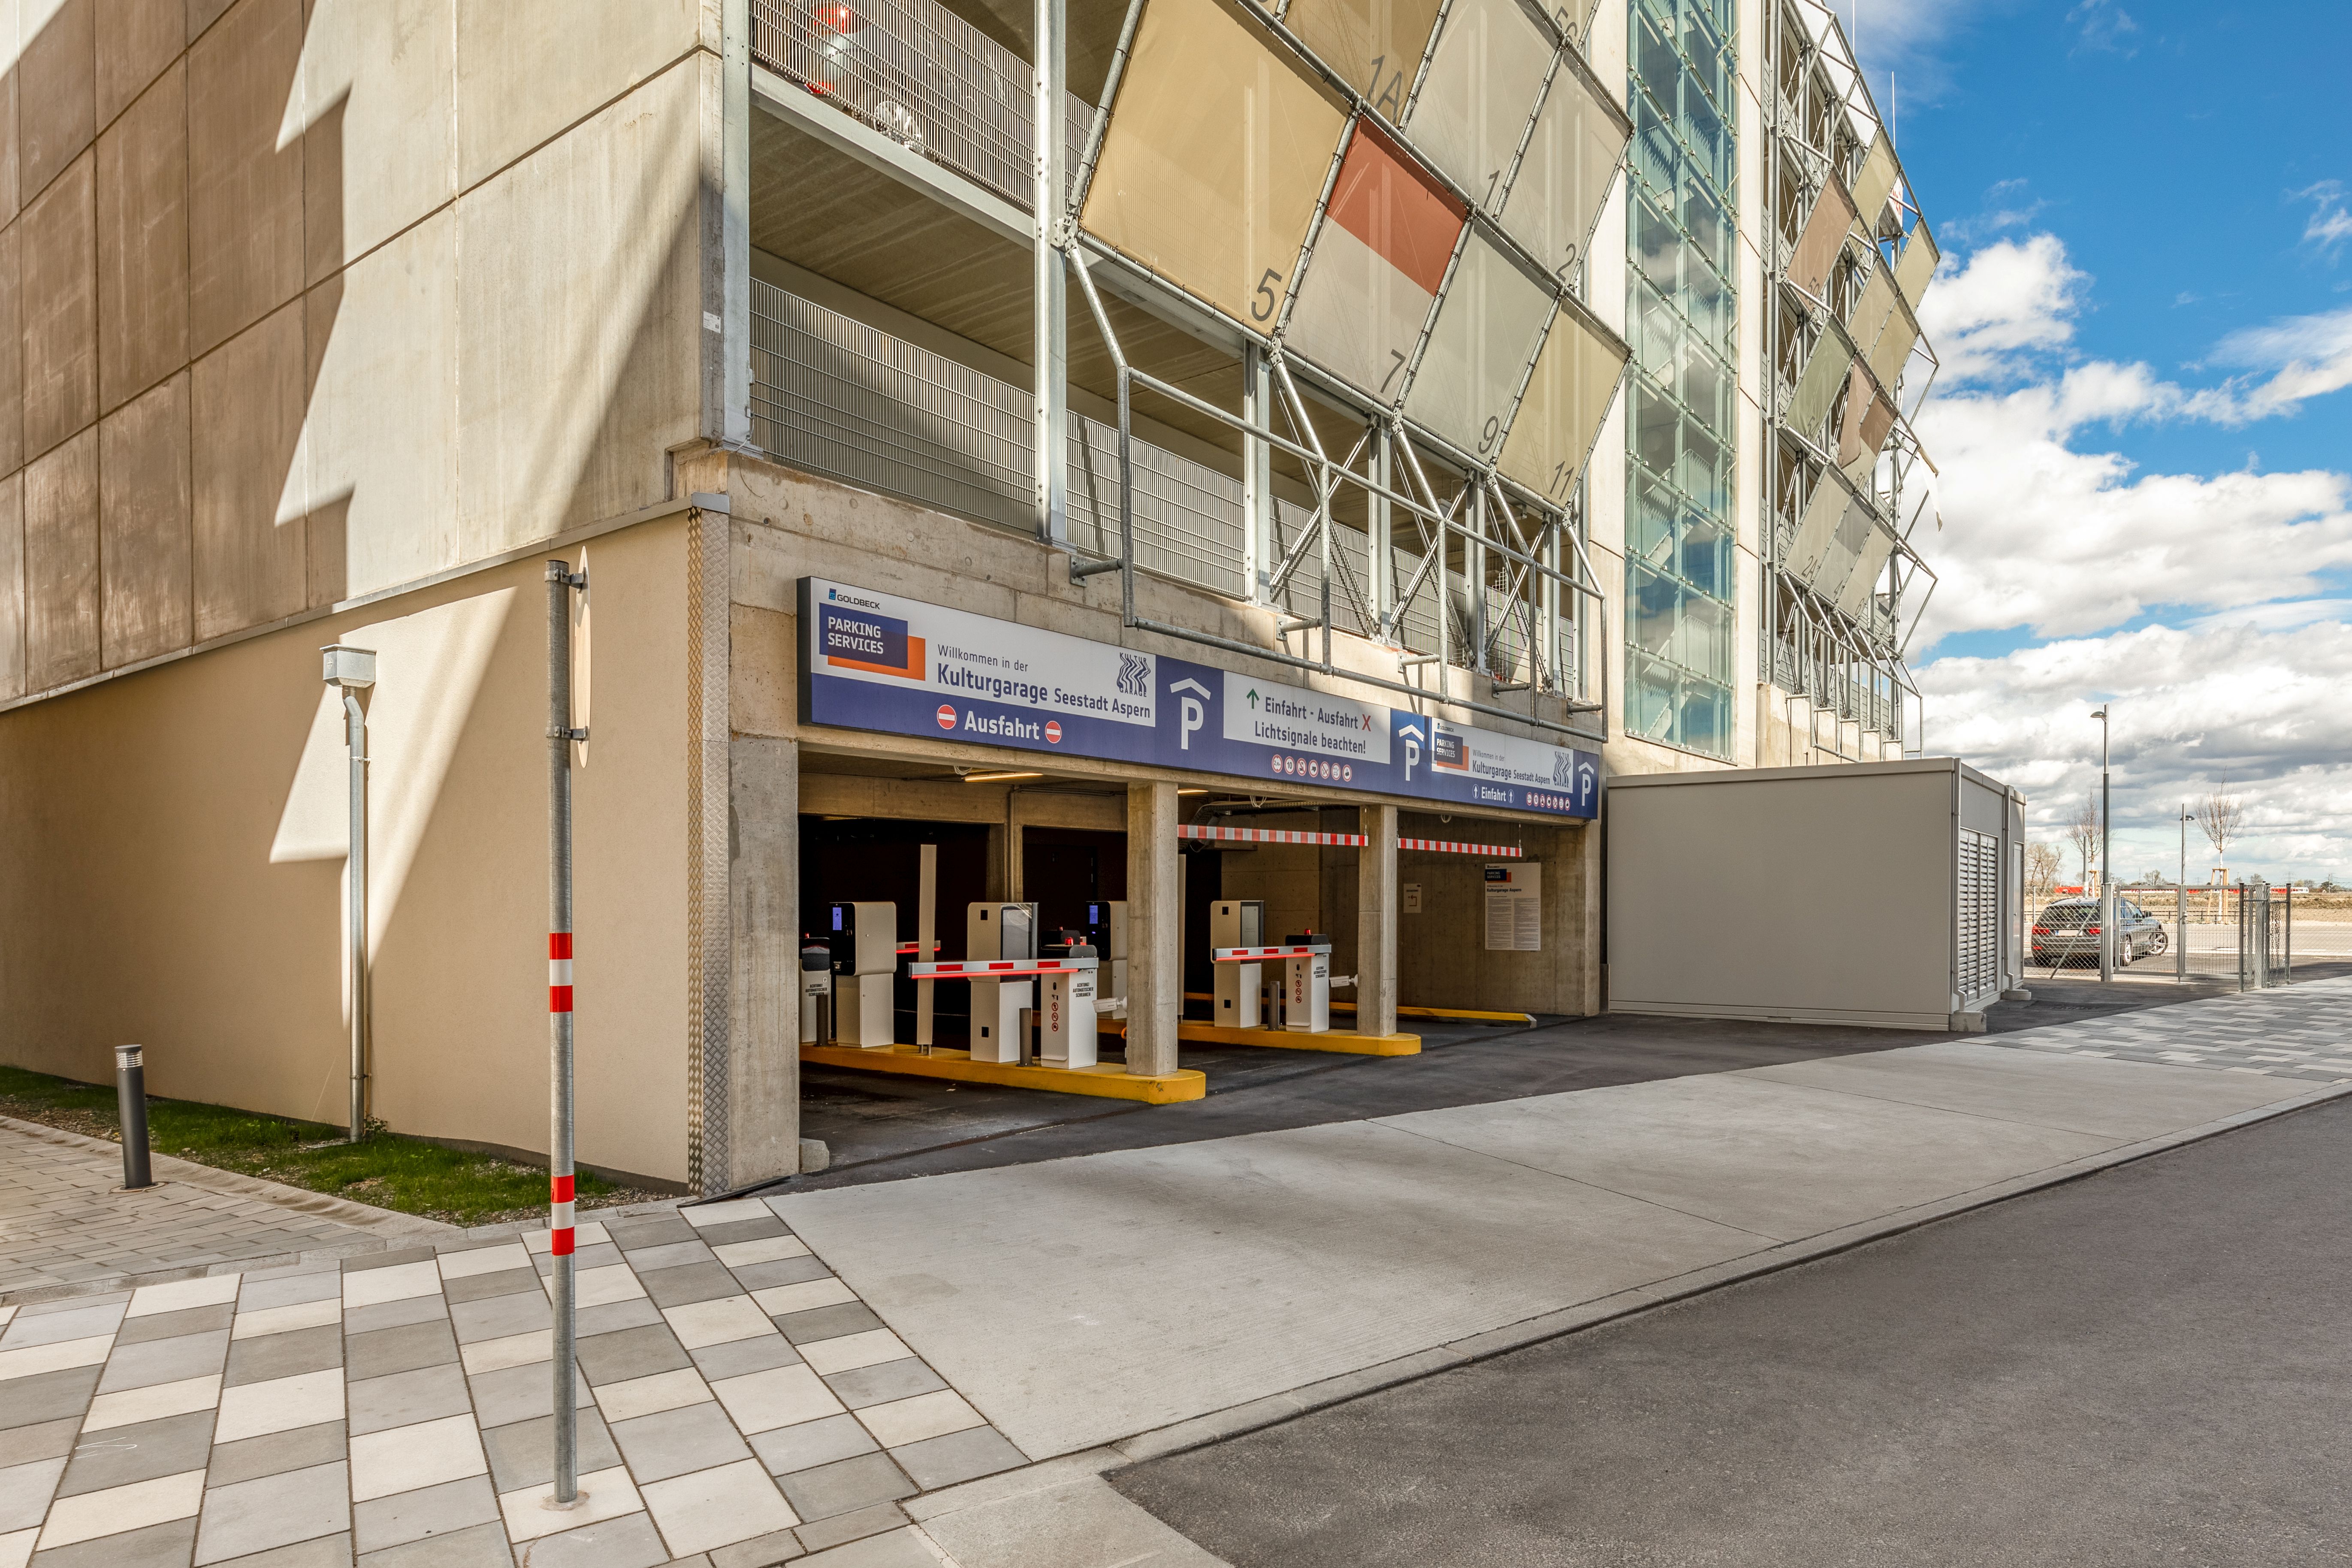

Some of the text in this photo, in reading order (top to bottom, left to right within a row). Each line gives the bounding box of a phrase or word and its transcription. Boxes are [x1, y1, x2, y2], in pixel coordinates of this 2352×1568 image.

[1367, 54, 1402, 124] 1A
[1483, 169, 1501, 209] 1
[1555, 243, 1576, 282] 2
[1251, 267, 1283, 322] 5
[1380, 348, 1407, 393] 7
[1478, 416, 1499, 454] 9
[1549, 461, 1574, 500] 11
[1801, 555, 1818, 581] 2A
[837, 594, 880, 610] GOLDBECK
[1855, 598, 1865, 616] 6
[828, 616, 881, 638] PARKING
[828, 633, 884, 654] SERVICES
[938, 644, 1028, 672] Willkommen in der
[938, 663, 1150, 718] Kulturgarage Seestadt Aspern
[1119, 686, 1147, 698] GARAGE
[964, 710, 1040, 740] Ausfahrt
[1181, 696, 1204, 750] P
[1265, 696, 1307, 719] Einfahrt
[1317, 707, 1359, 729] Ausfahrt
[1255, 721, 1366, 754] Lichtsignale beachten!
[1437, 738, 1455, 749] PARKING
[1437, 747, 1455, 758] SERVICES
[1405, 739, 1420, 781] P
[1473, 749, 1494, 760] Willkommen
[1473, 760, 1550, 785] Kulturgarage Seestadt Aspern
[1481, 786, 1506, 801] Einfahrt
[1582, 773, 1591, 806] P
